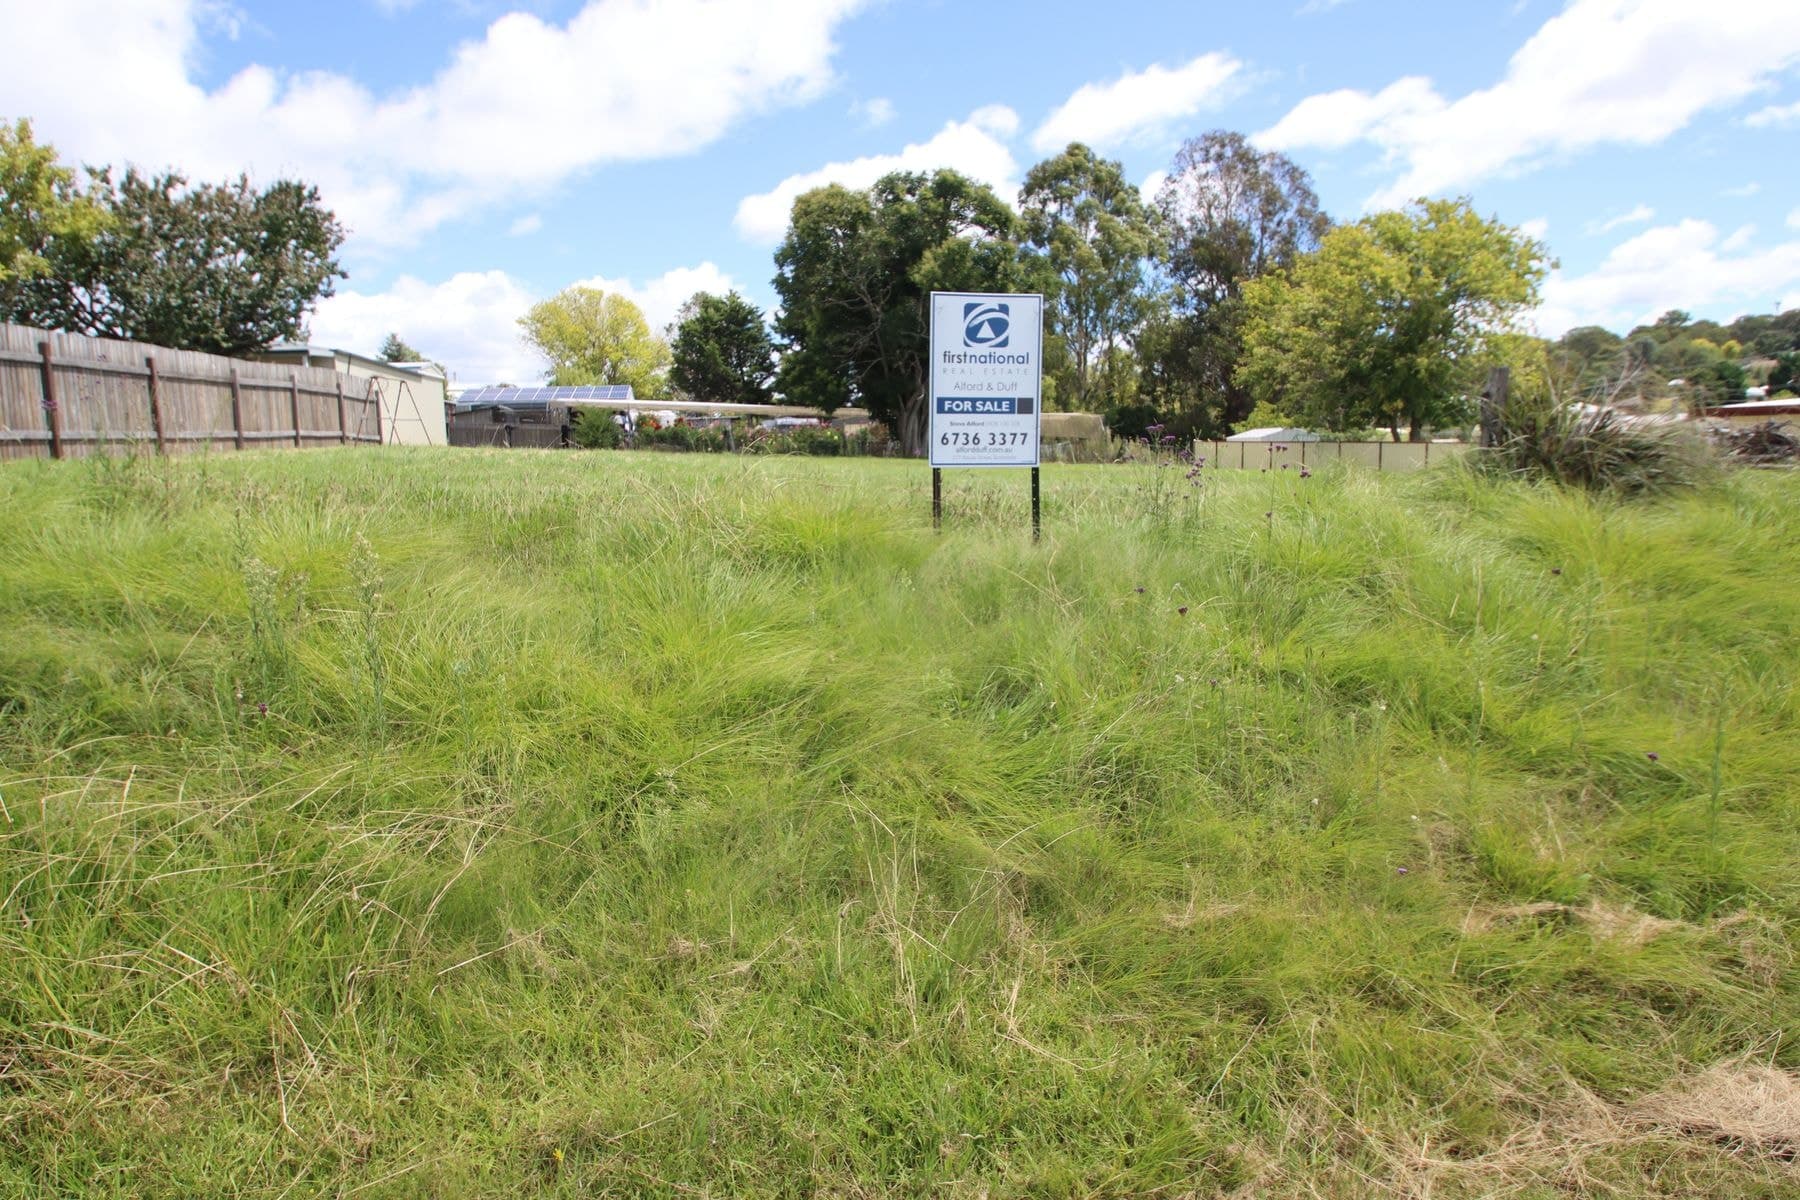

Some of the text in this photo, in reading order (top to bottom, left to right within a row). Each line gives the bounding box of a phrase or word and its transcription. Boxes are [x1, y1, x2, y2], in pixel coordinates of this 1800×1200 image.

[953, 382, 1018, 391] Alford & Duff
[944, 401, 1010, 411] FOR SALE
[941, 432, 1028, 445] 6736 3377
